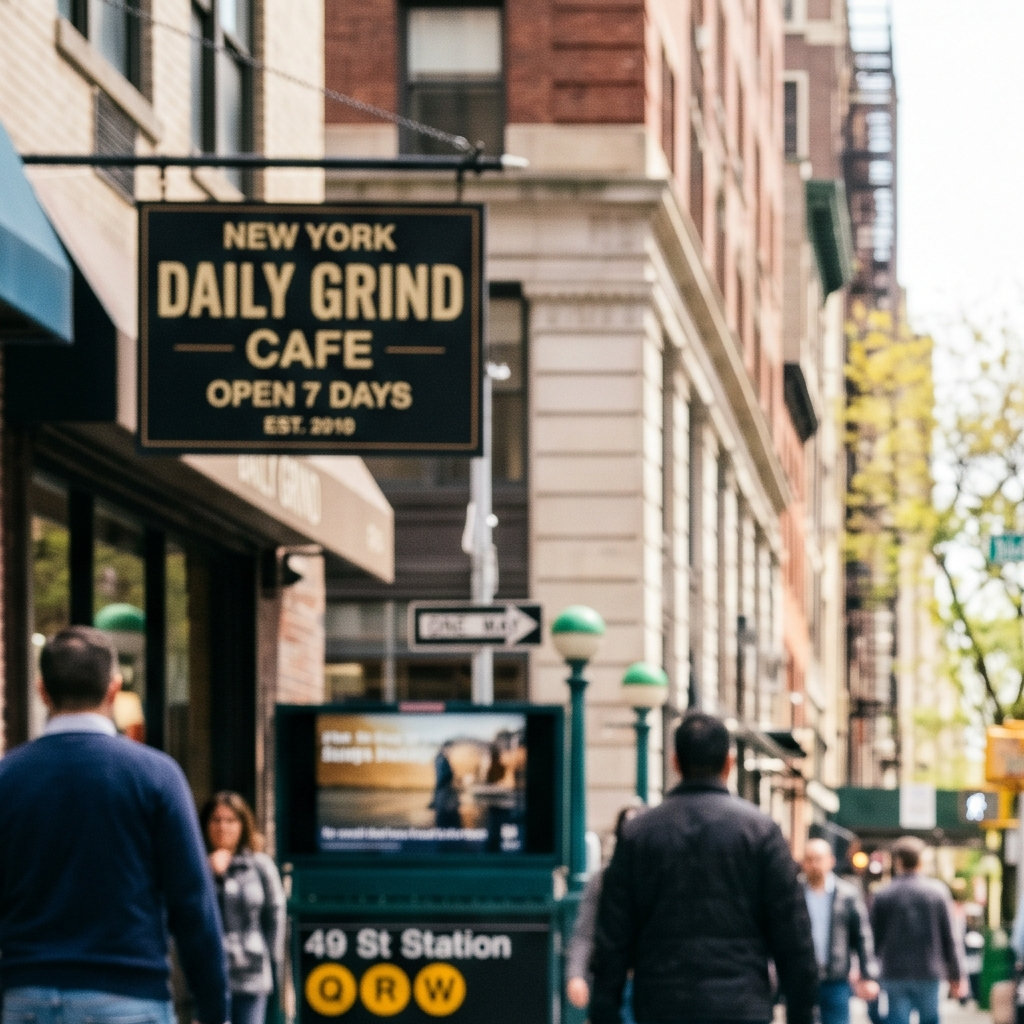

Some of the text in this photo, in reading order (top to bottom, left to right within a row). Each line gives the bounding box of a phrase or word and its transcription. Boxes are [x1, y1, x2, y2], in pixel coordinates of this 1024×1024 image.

[223, 222, 397, 251] NEW YORK
[157, 261, 465, 321] DAILY GRIND
[245, 329, 374, 369] CAFE
[206, 379, 413, 409] OPEN 7 DAYS
[263, 415, 307, 435] EST.
[305, 927, 512, 960] 49 St Station
[319, 975, 455, 1002] Q R W
